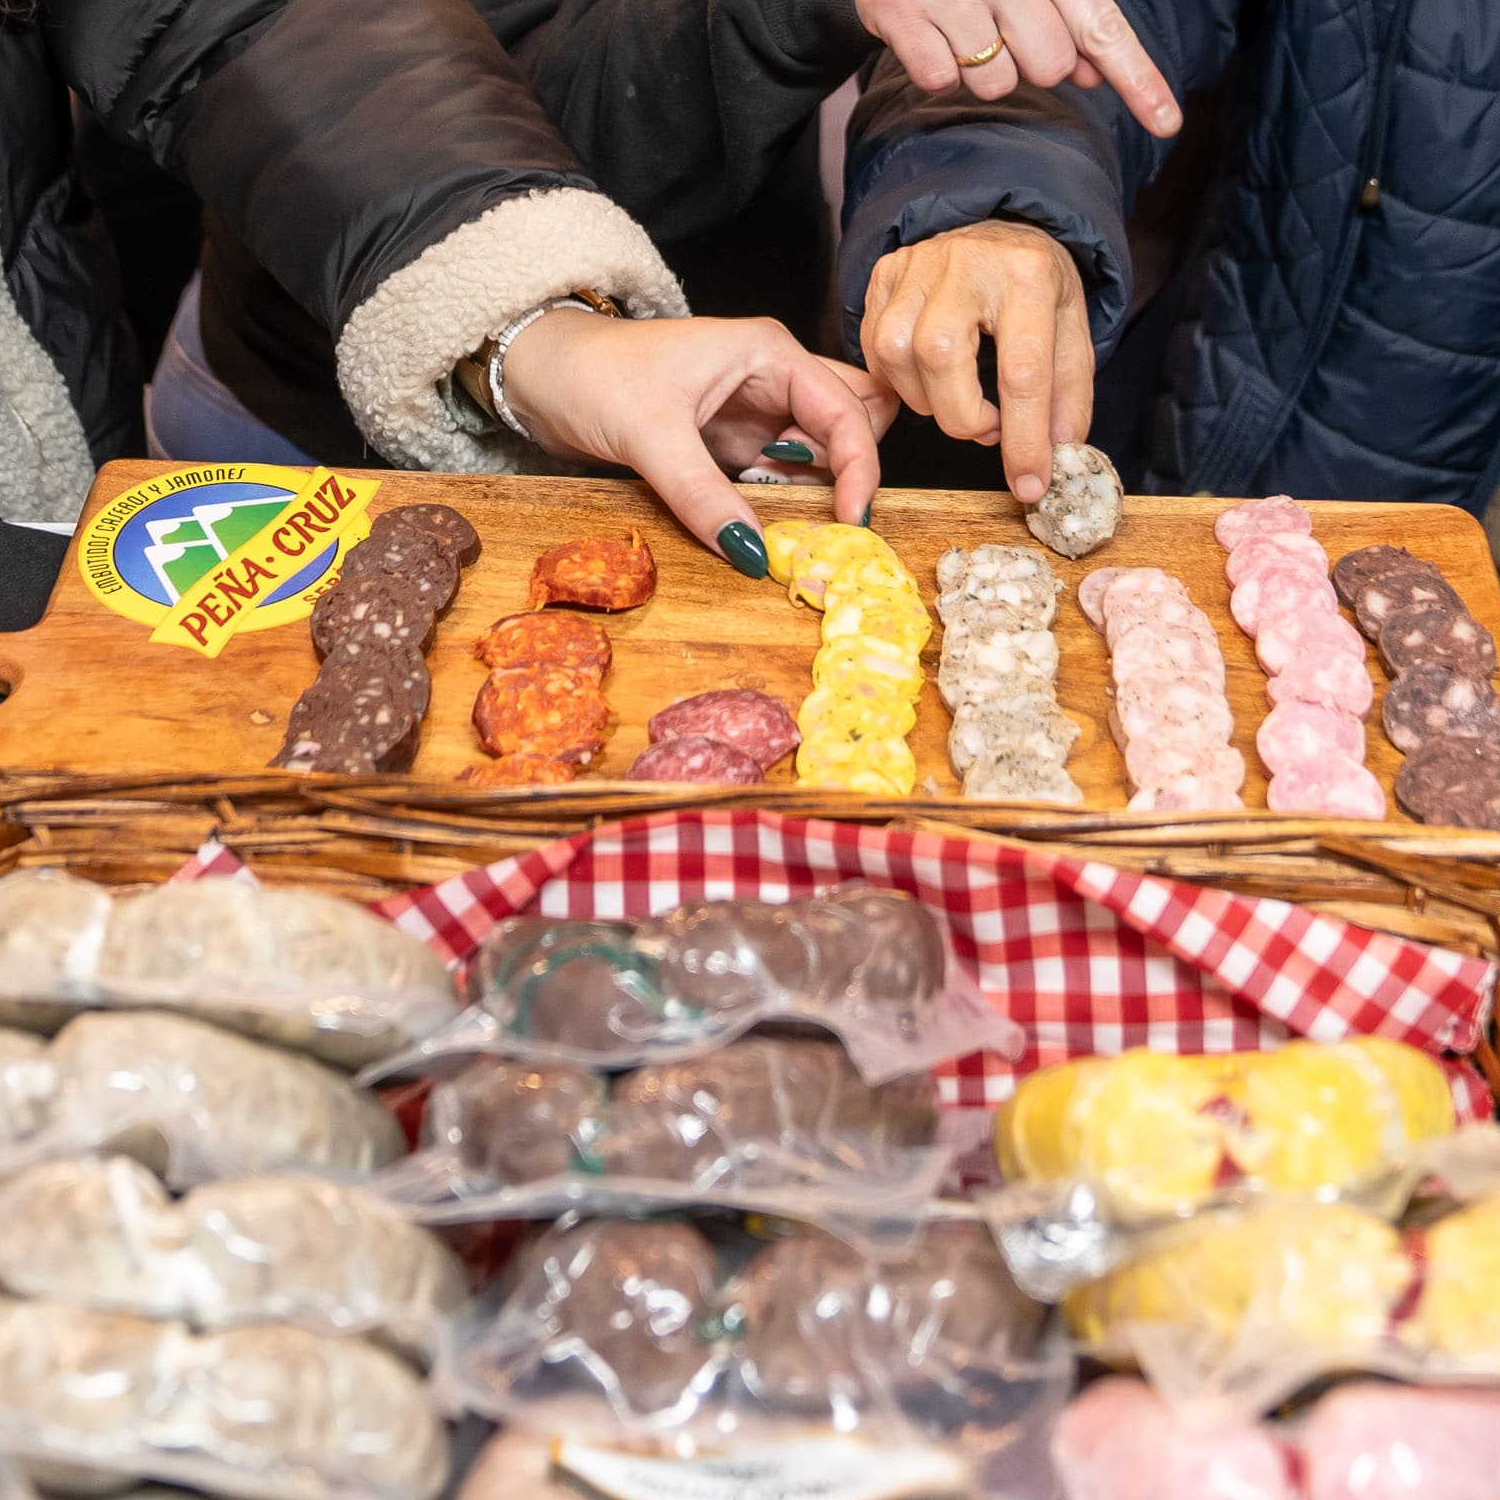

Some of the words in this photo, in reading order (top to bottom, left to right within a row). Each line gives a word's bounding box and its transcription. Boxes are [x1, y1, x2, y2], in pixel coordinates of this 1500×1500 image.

[148, 483, 162, 495] Y
[165, 468, 246, 491] JAMONES
[95, 490, 149, 532] CASEROS
[86, 534, 123, 595] EMBUTIDOS
[178, 557, 279, 647] PEÑA
[272, 475, 356, 556] CRUZ
